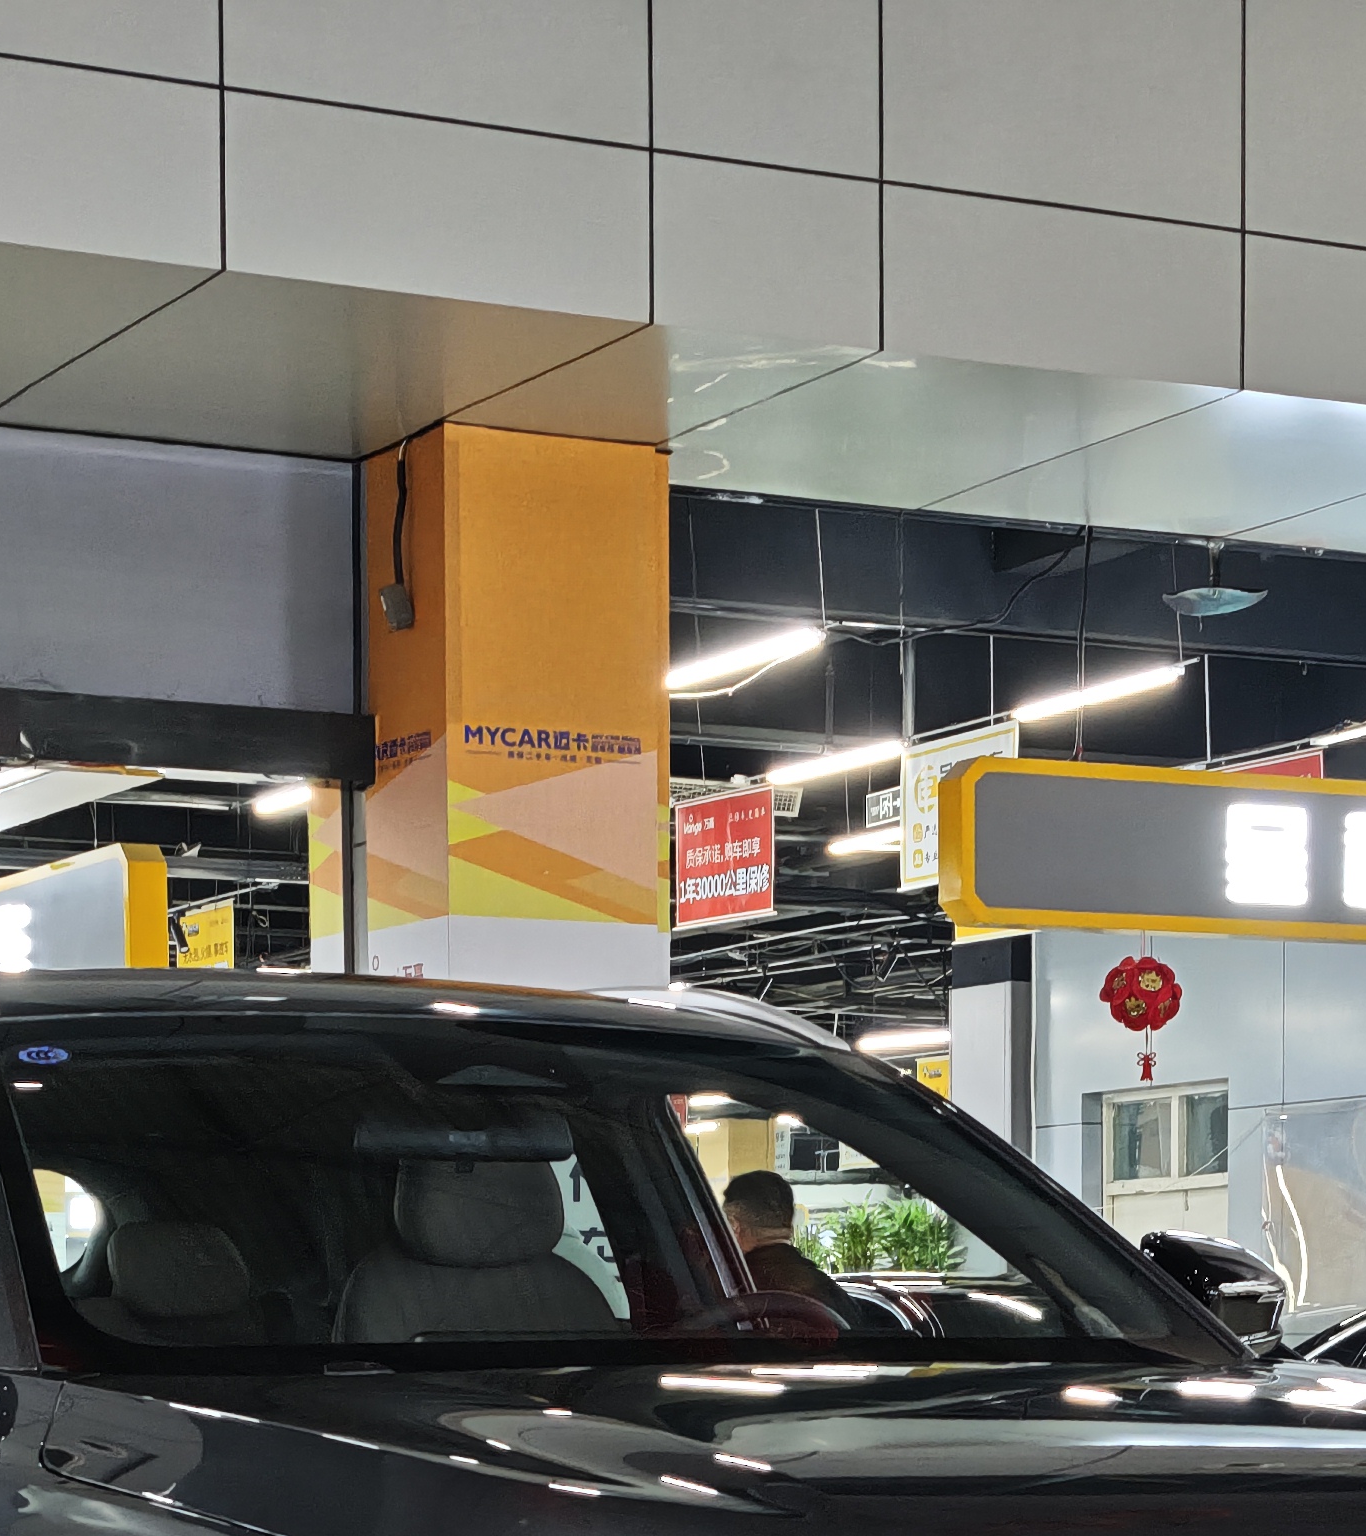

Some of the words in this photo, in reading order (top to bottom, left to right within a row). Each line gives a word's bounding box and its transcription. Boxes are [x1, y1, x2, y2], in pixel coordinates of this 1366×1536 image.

[679, 863, 770, 905] 1年30000公里保修
